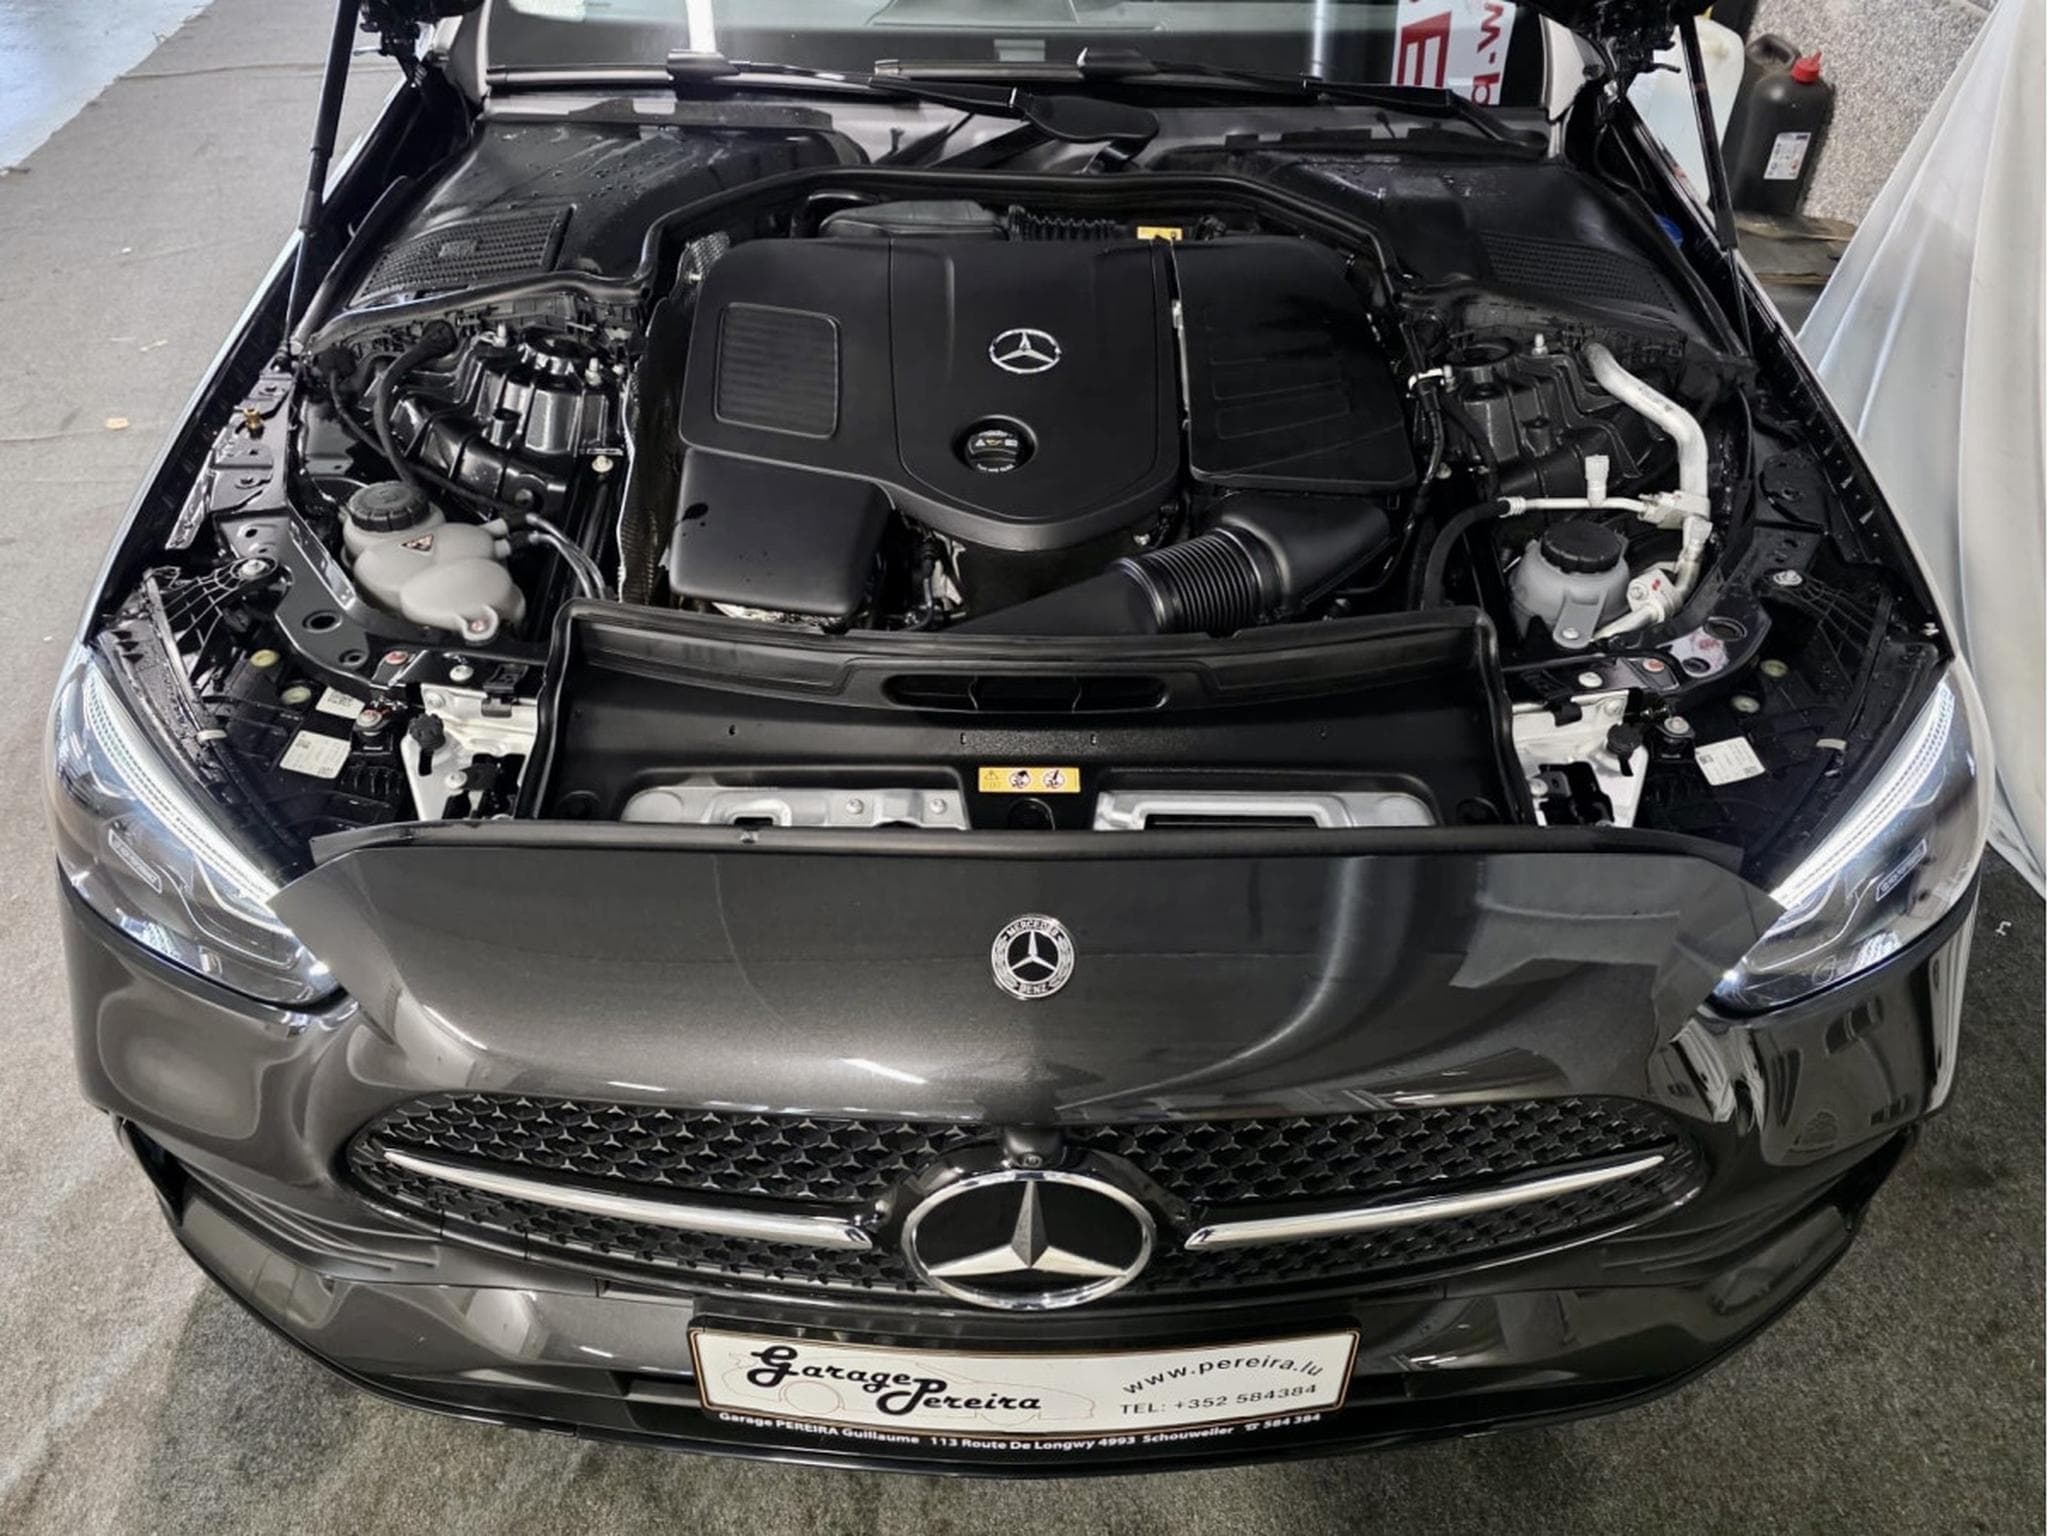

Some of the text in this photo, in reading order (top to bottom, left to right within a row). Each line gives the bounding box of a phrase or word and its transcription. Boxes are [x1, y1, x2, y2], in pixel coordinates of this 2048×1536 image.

[747, 1345, 911, 1393] Garage
[1123, 1355, 1324, 1394] www.pereira.lu
[876, 1378, 1041, 1416] Pereira
[1120, 1384, 1317, 1415] TEL: +352 584384
[719, 1412, 1321, 1451] Garage PEREIRA Guillaume 113 Route De Longwy 4993 Schouweiler 584 384
